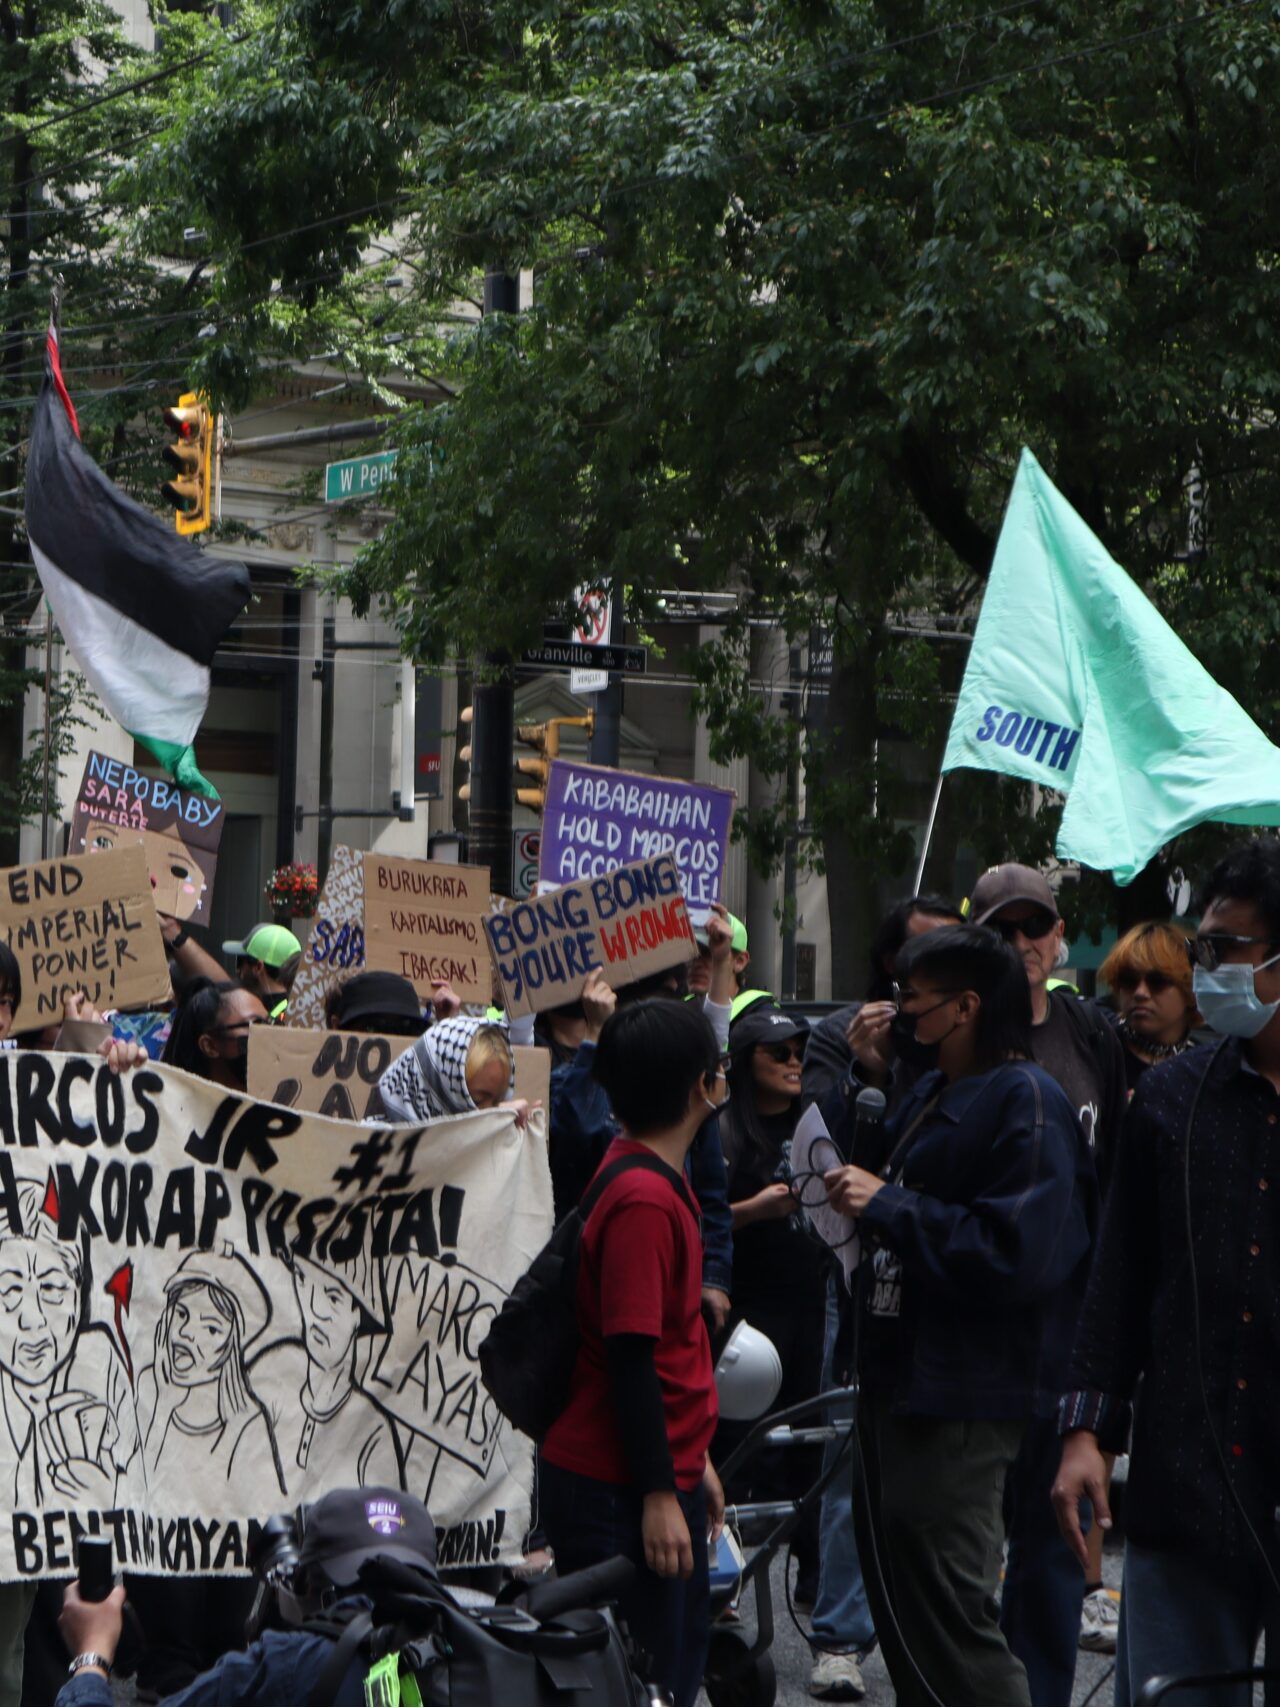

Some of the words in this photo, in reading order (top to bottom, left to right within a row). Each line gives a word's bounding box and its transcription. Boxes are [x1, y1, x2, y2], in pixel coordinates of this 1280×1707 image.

[340, 466, 354, 493] W
[976, 705, 1082, 772] SOUTH
[80, 800, 149, 832] DUTERTE
[85, 779, 145, 818] SARA
[558, 813, 622, 852] HOLD
[630, 826, 720, 874] MARCOS
[8, 864, 83, 904] END
[378, 865, 468, 899] BURUKRATA
[488, 888, 590, 956] BONG
[590, 856, 680, 921] BONG
[7, 899, 142, 949] IMPERIAL
[390, 910, 478, 945] KAPITALISMO,
[599, 895, 696, 964] WRONG
[31, 938, 138, 984] POWER
[399, 950, 478, 984] IBAGSAK!
[312, 1034, 392, 1085] NO
[184, 1094, 303, 1174] JR
[331, 1127, 428, 1193] #1
[56, 1154, 232, 1251] KORAP
[390, 1254, 499, 1362] MARC
[368, 1501, 398, 1516] SEIU
[380, 1520, 392, 1535] 2
